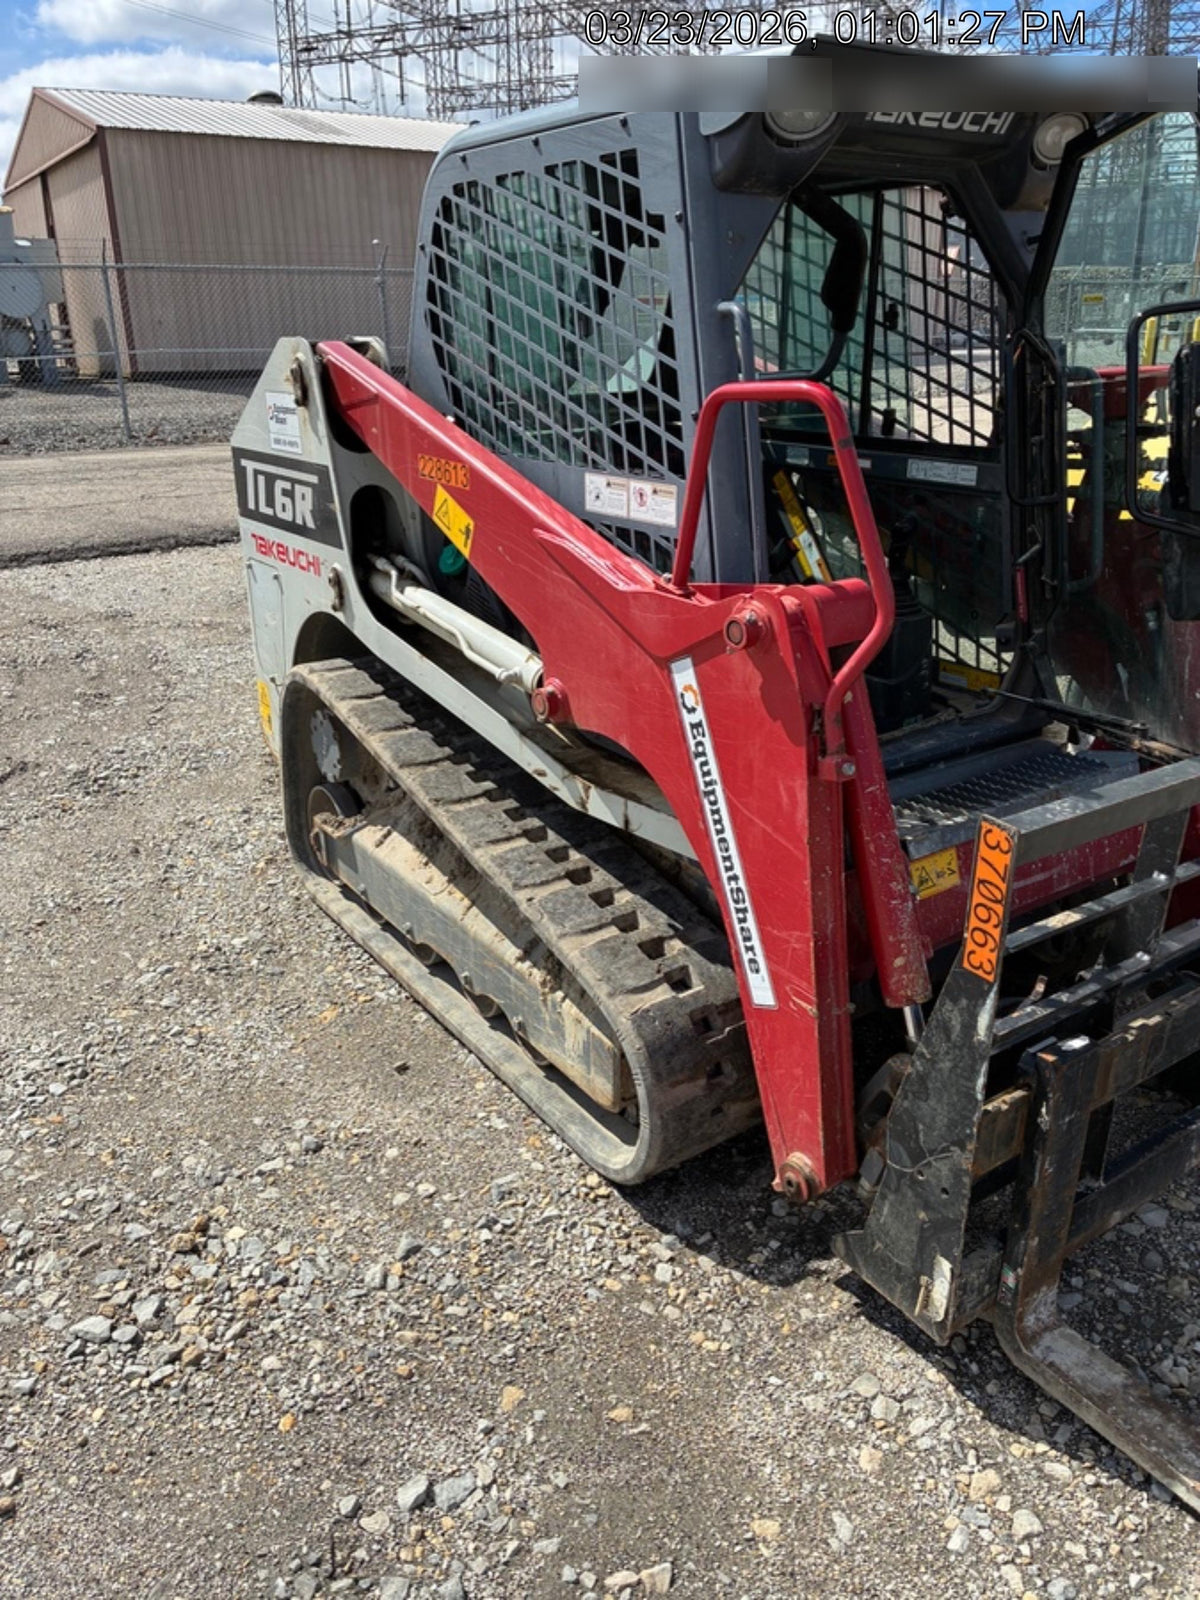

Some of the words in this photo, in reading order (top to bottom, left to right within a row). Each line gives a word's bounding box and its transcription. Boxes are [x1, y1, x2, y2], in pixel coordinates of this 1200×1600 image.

[240, 458, 319, 529] TL6R
[419, 455, 469, 488] 228613
[689, 719, 761, 975] EquipmentShare
[966, 828, 1012, 976] 370663
